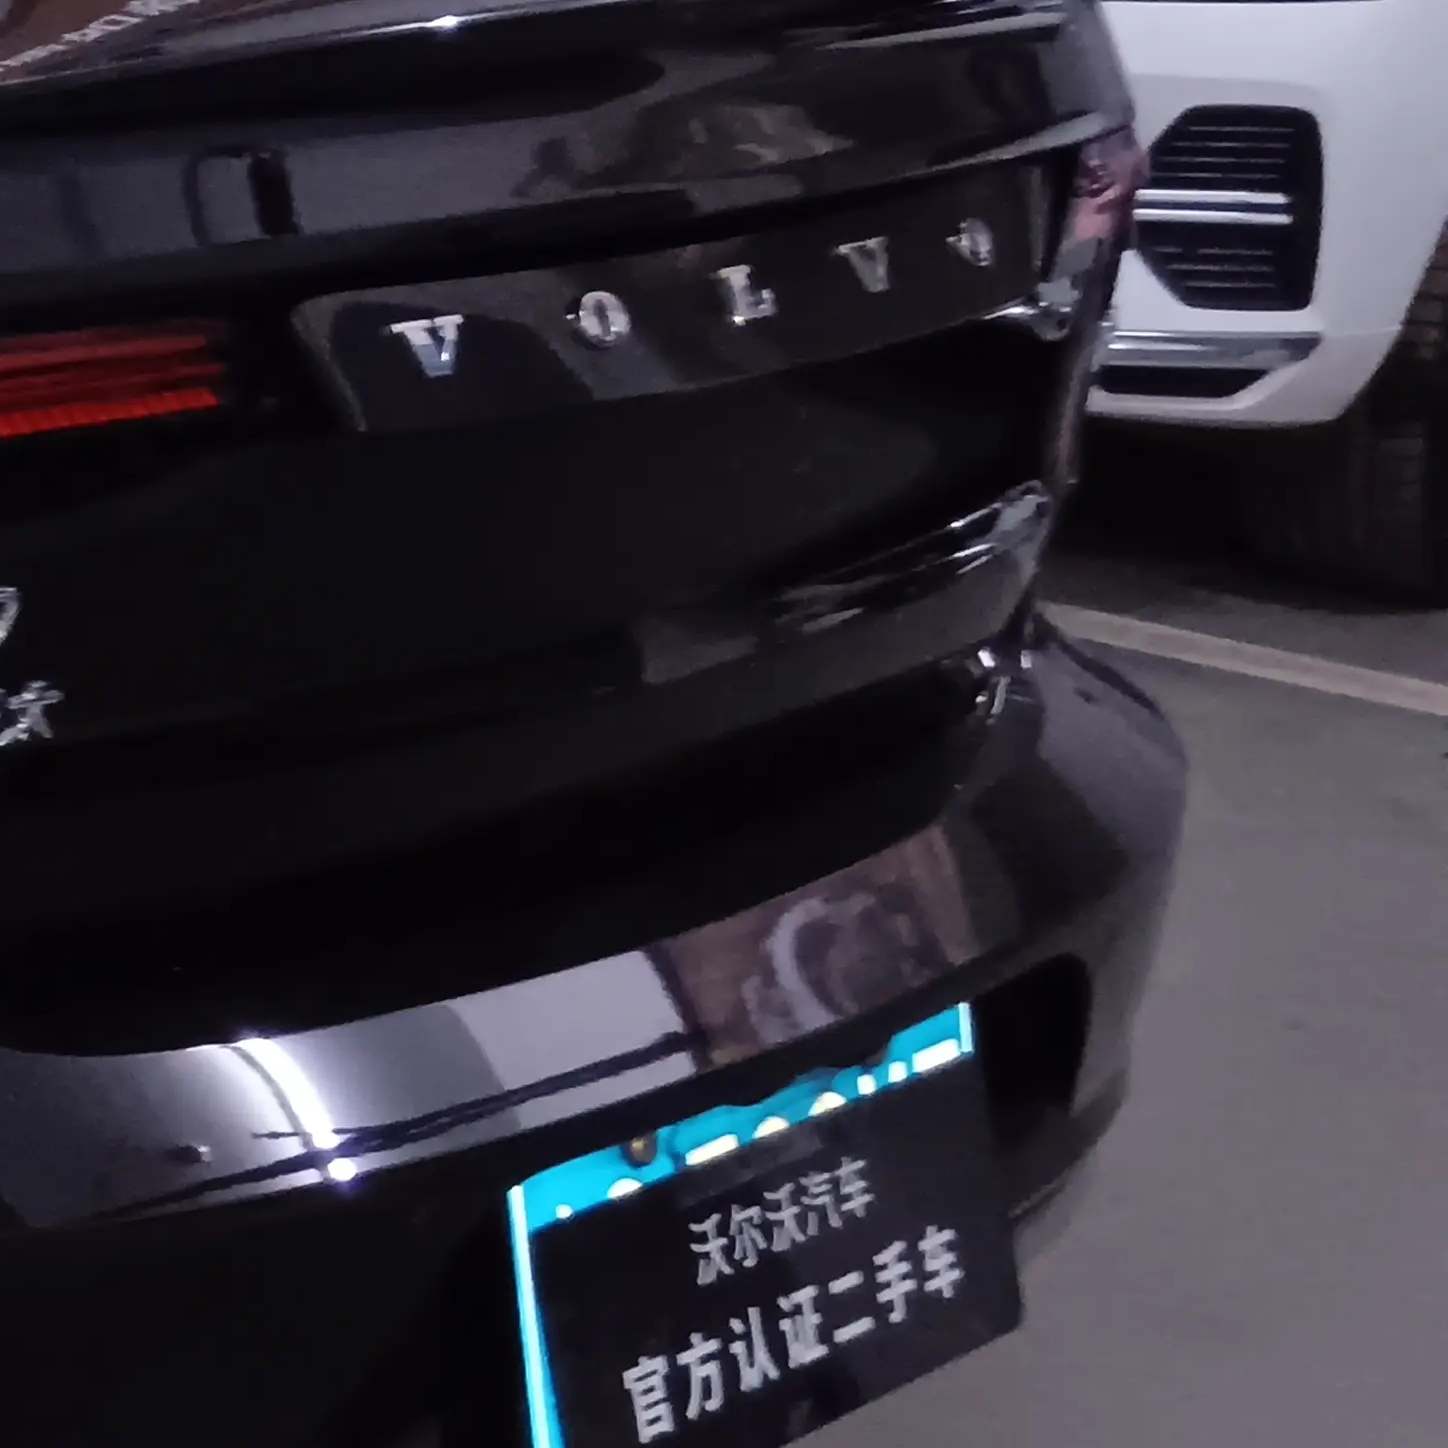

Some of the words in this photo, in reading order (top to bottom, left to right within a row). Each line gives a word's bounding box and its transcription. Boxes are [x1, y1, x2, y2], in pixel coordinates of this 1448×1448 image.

[386, 217, 996, 377] VOLVO
[689, 1157, 876, 1286] 沃尔沃汽车
[623, 1225, 964, 1445] 官方认证二手车
